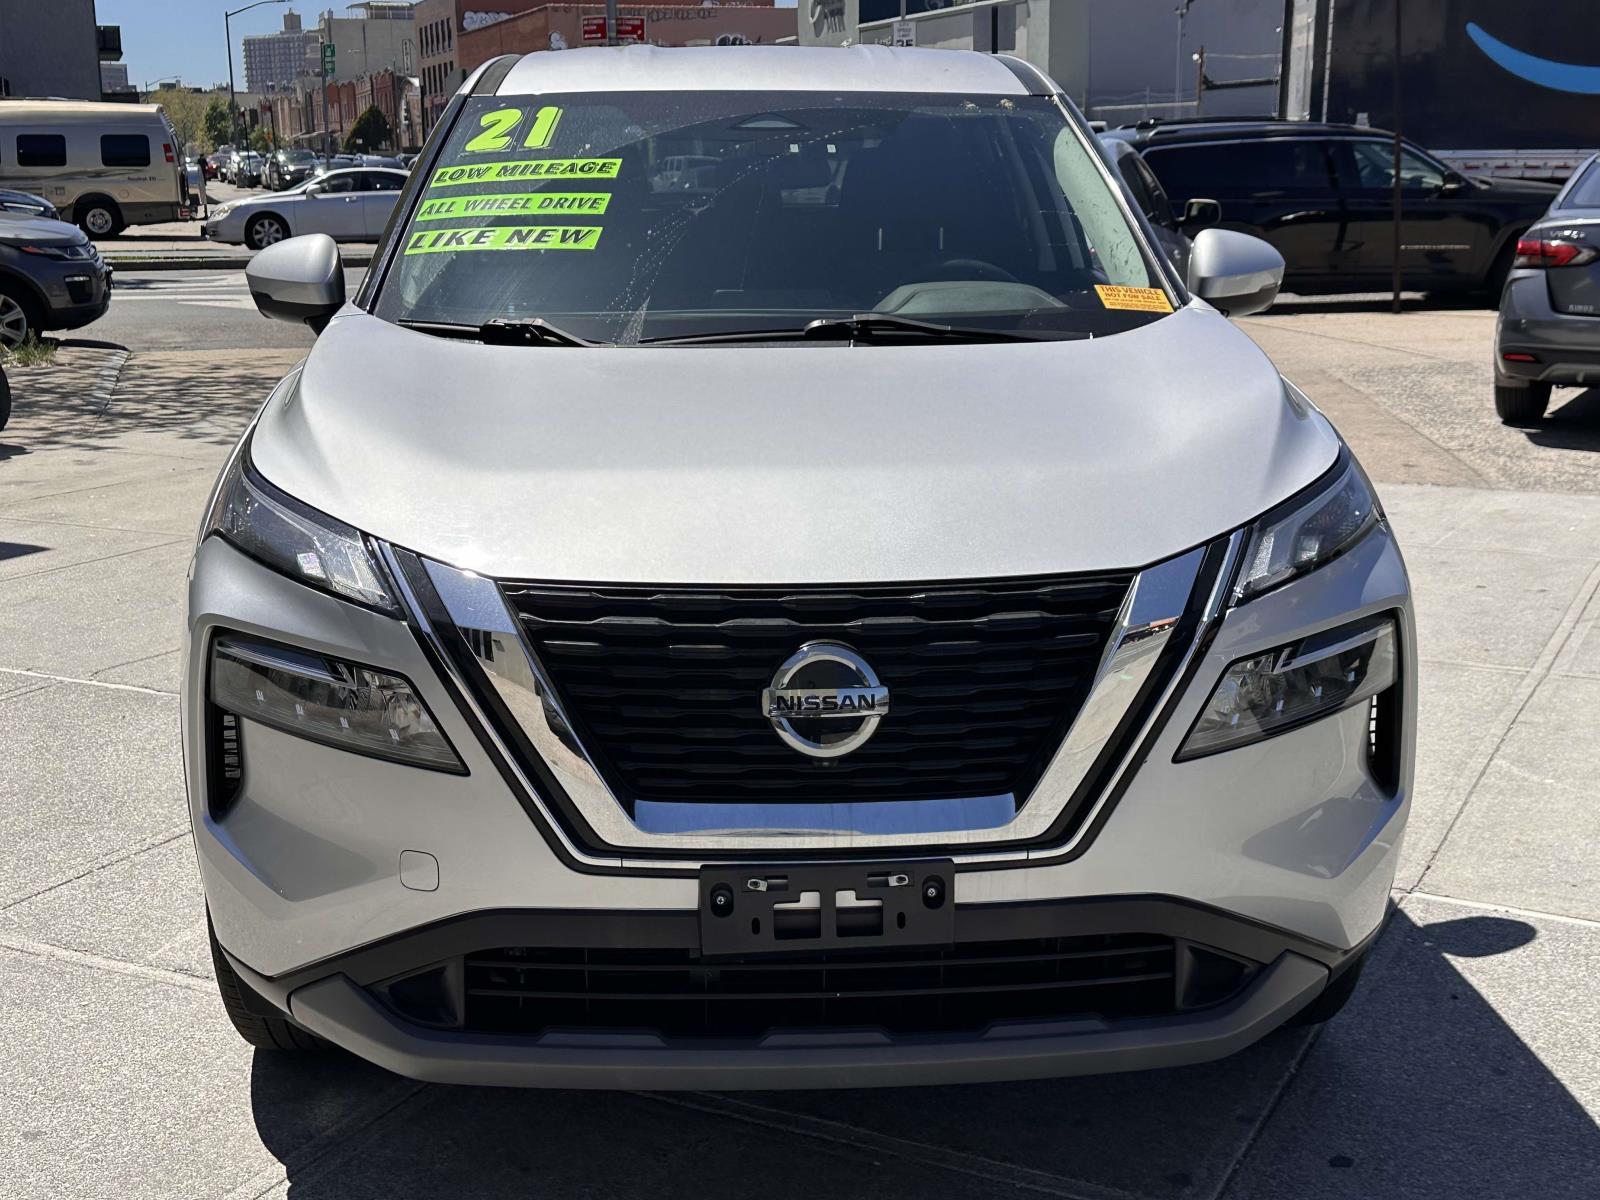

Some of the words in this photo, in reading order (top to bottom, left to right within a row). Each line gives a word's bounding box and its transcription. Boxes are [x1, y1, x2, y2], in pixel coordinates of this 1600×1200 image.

[465, 106, 563, 152] 21
[434, 167, 492, 183] LOW
[496, 162, 616, 176] MILEAGE
[421, 201, 455, 216] ALL
[463, 198, 531, 211] WHEEL
[537, 197, 605, 210] DRIVE
[408, 229, 494, 249] LIKE
[504, 228, 597, 244] NEW
[1121, 287, 1160, 295] VEHICLE
[776, 694, 876, 711] NISSAN
